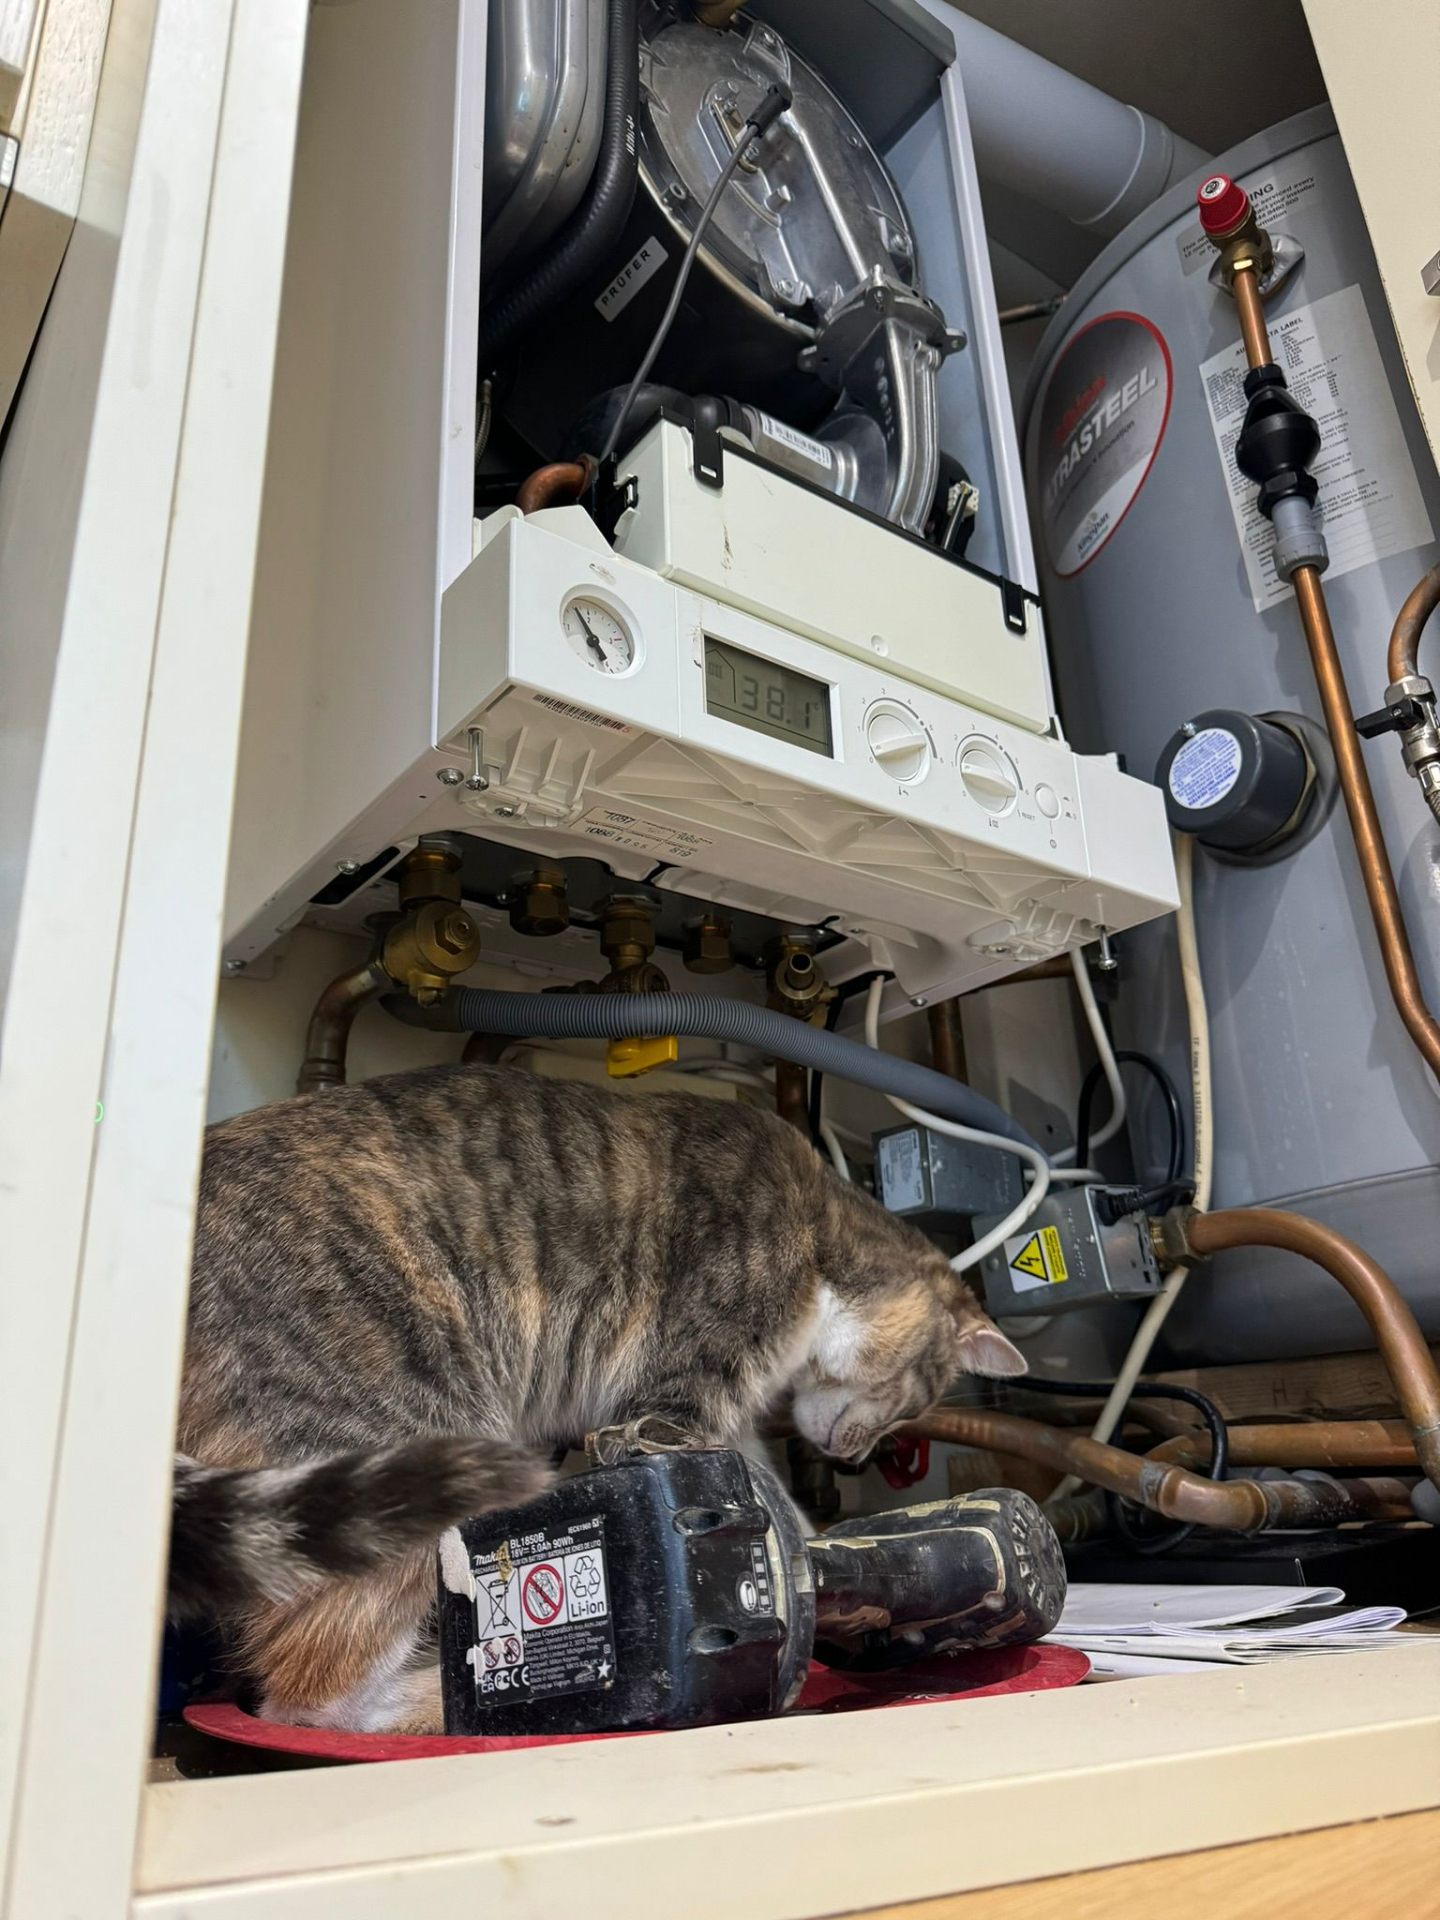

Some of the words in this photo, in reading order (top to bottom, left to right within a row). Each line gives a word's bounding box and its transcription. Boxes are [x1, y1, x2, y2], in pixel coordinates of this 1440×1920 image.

[1280, 317, 1302, 332] LABEL
[1047, 366, 1156, 502] TRASTEEL
[509, 1532, 546, 1550] BL1850B
[552, 1535, 574, 1549] 90Wh
[571, 1601, 604, 1617] Li-ion
[541, 1625, 573, 1637] Corporation
